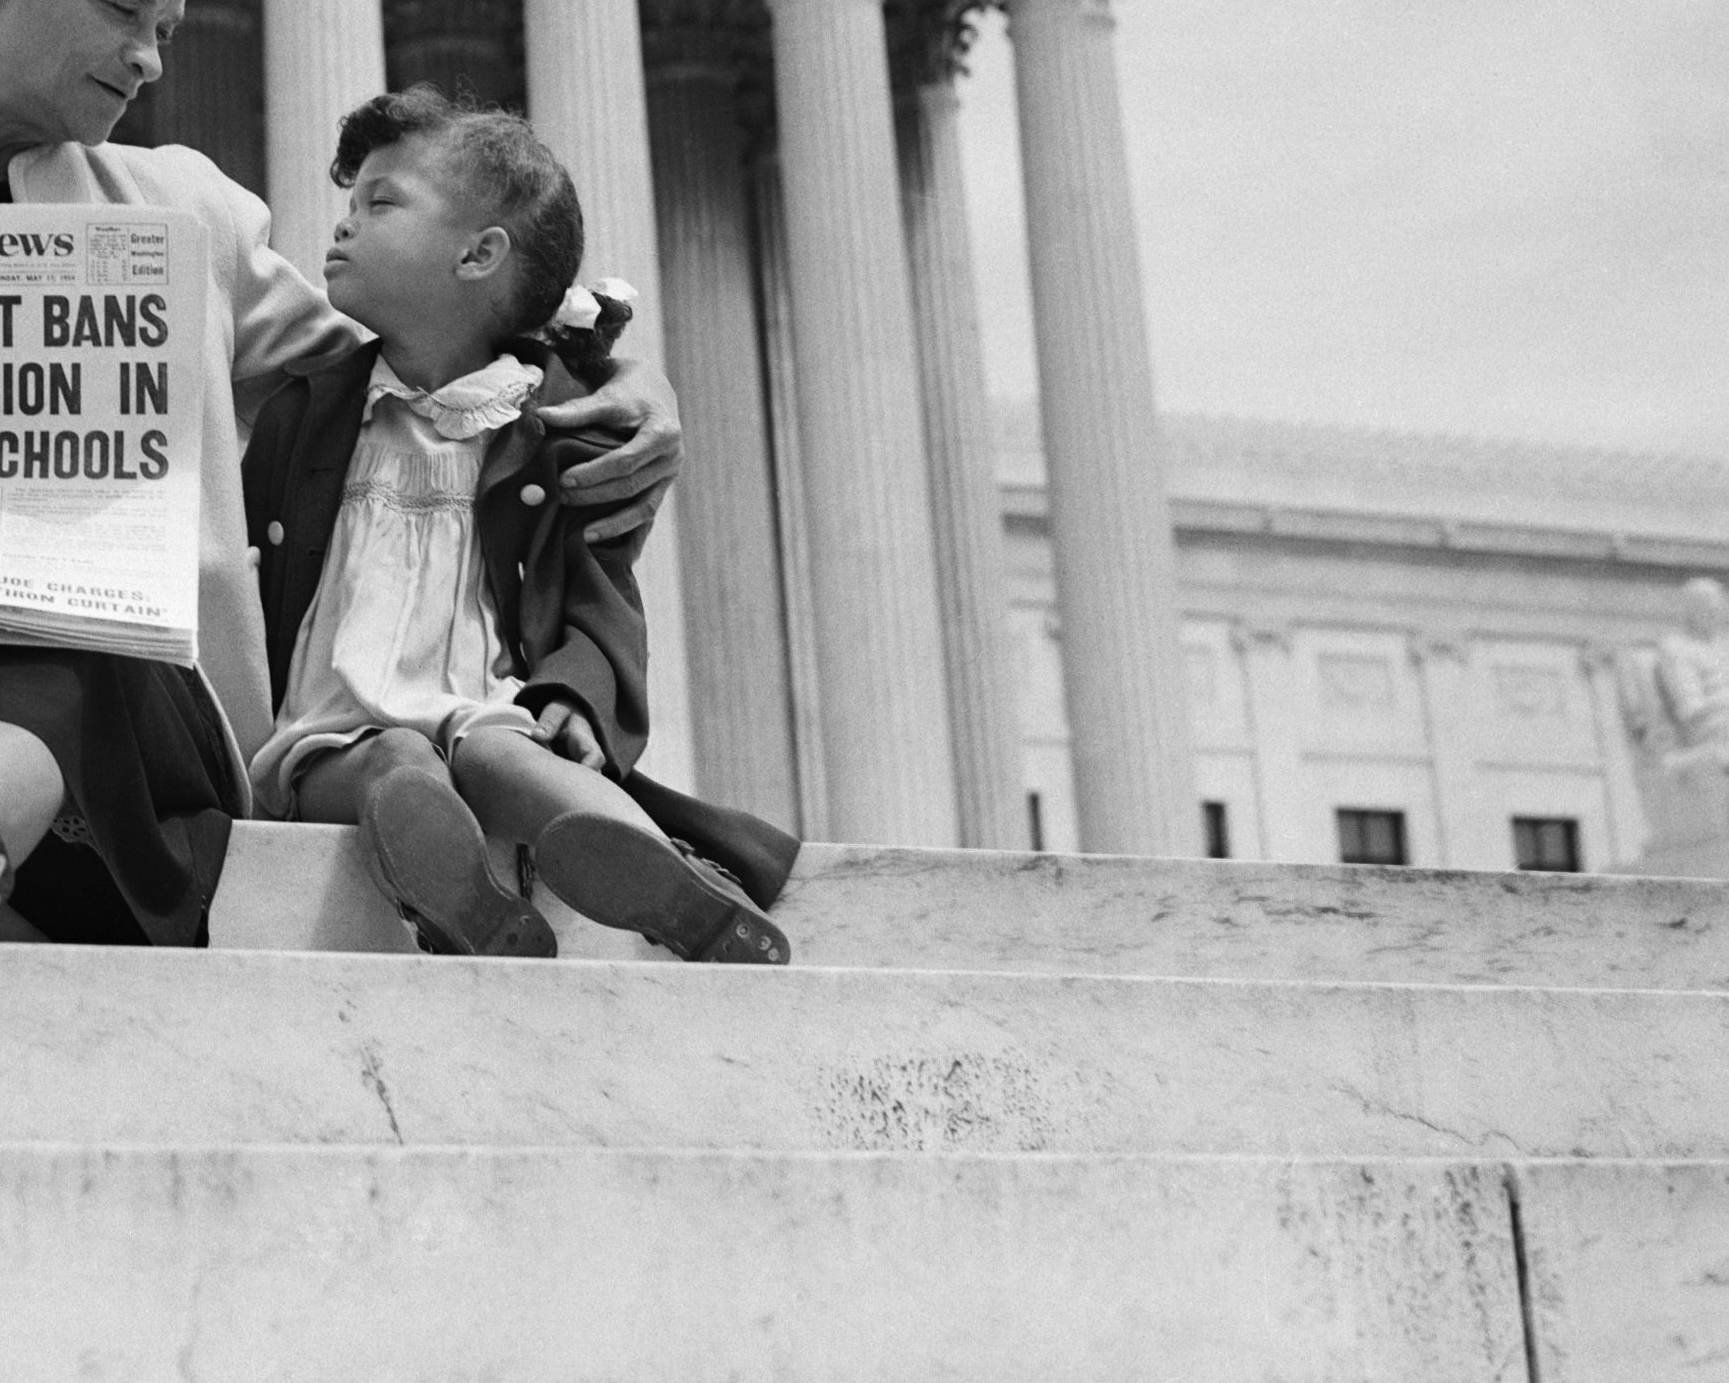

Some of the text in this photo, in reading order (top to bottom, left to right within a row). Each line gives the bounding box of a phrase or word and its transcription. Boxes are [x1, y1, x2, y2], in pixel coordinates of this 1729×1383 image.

[130, 233, 165, 245] Greater
[132, 264, 164, 276] Edition
[26, 274, 42, 282] MAY
[43, 293, 169, 348] BANS
[119, 362, 168, 417] IN
[2, 575, 35, 590] JOE
